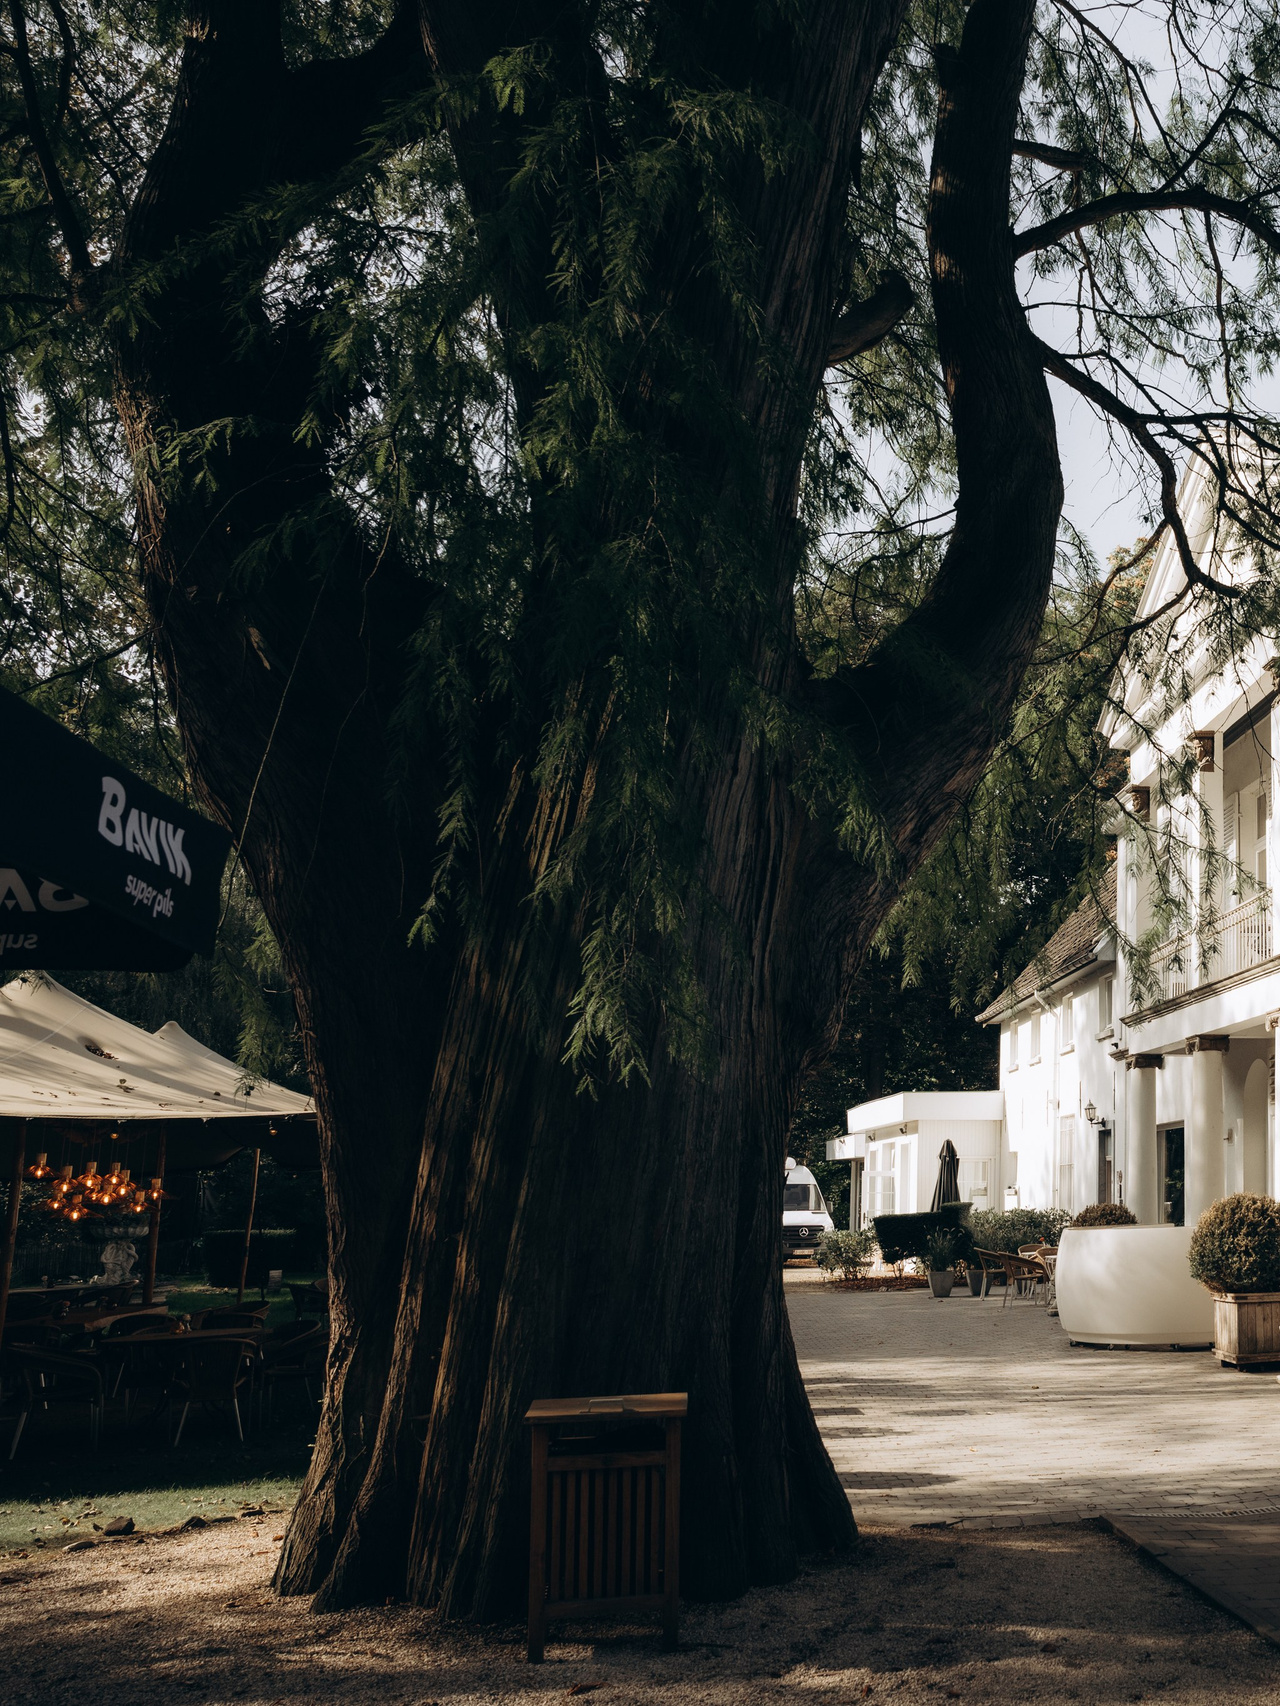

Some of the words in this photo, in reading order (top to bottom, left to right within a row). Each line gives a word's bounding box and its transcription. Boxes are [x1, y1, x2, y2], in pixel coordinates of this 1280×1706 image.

[98, 776, 192, 886] BAVIK
[125, 874, 156, 906] super
[152, 888, 175, 918] pils
